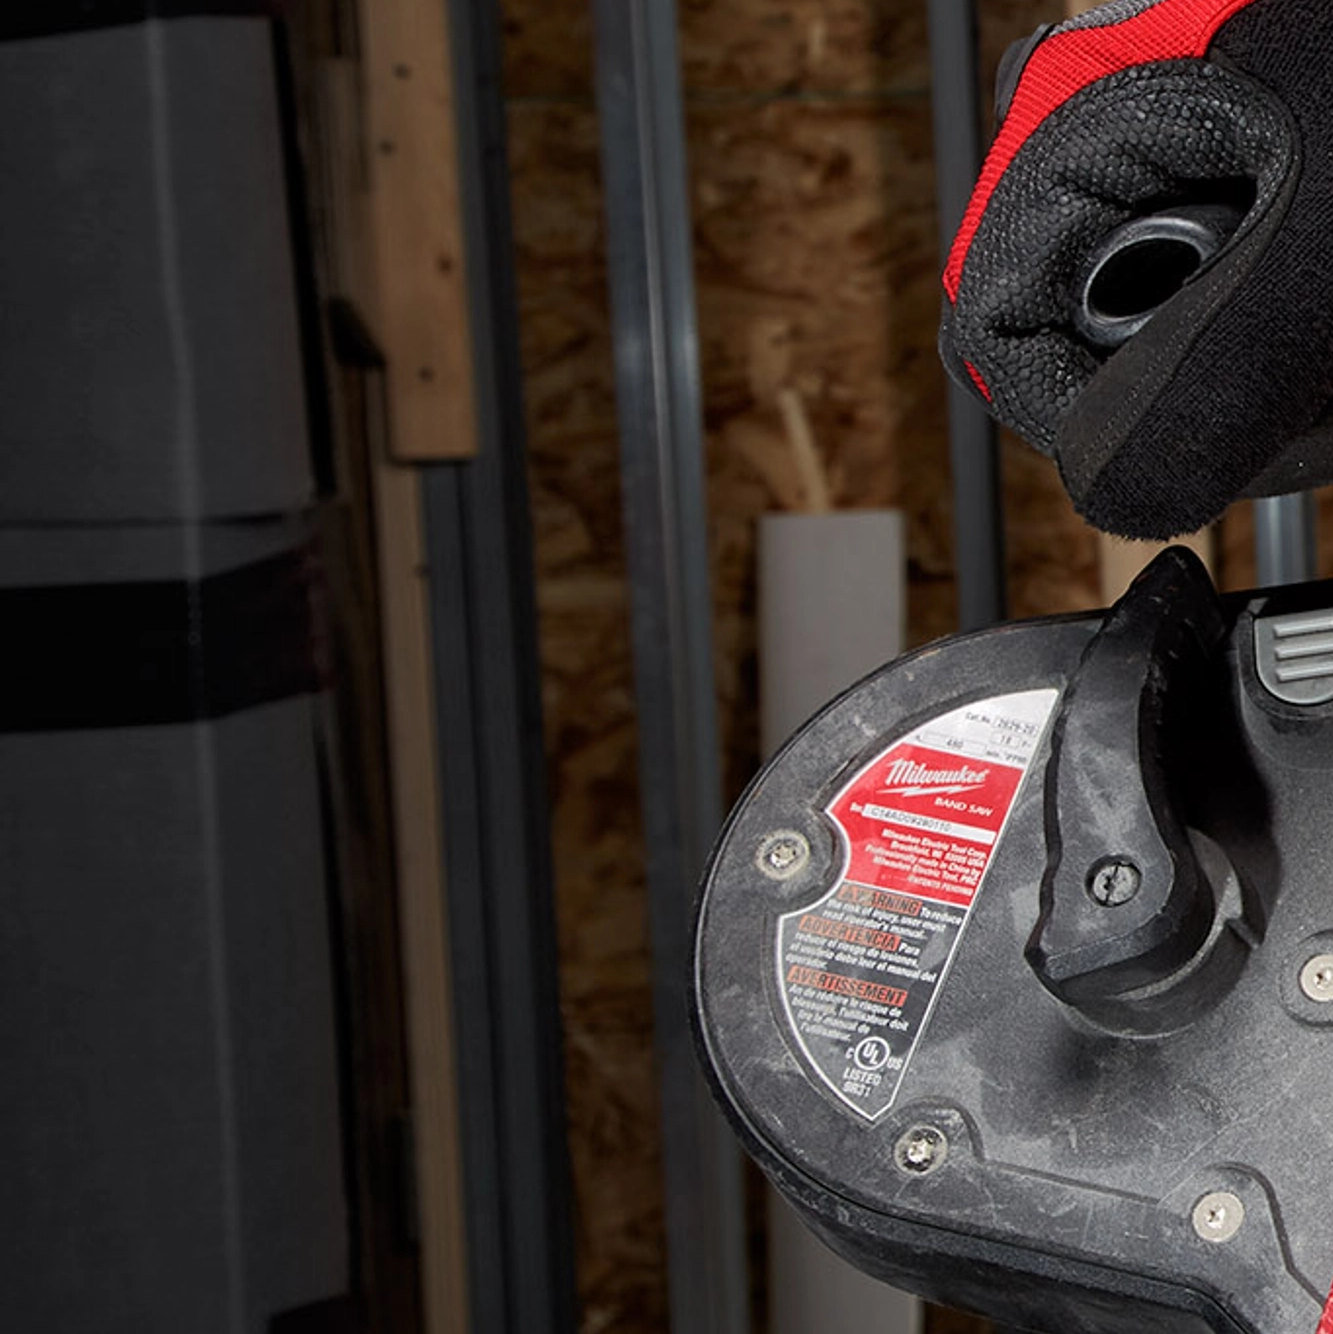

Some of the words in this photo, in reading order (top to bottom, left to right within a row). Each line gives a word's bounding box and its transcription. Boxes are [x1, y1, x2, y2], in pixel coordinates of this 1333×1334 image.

[884, 758, 990, 785] Milwaukee
[934, 796, 967, 811] BAND
[968, 803, 994, 817] SAW
[882, 829, 920, 843] Milwaukee
[856, 888, 919, 912] WARNING
[802, 917, 897, 949] ADVERTENCIA
[792, 967, 905, 1003] AVERTISSEMENT
[862, 1042, 878, 1065] UL
[843, 1067, 882, 1085] LISTED
